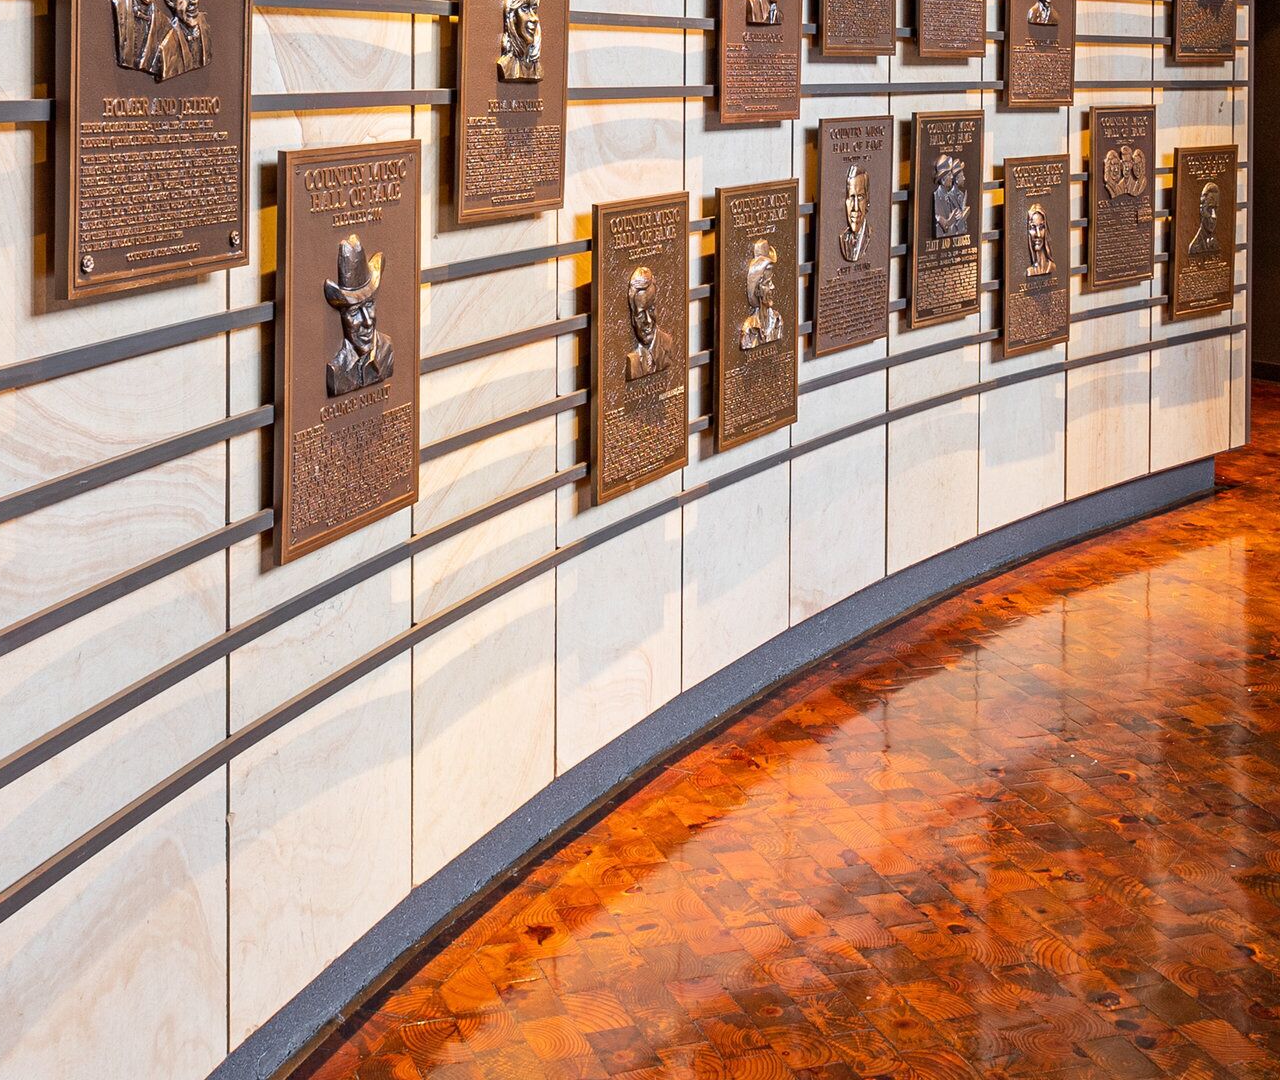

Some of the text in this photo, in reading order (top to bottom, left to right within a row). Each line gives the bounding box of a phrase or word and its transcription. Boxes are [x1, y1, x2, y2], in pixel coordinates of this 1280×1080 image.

[304, 158, 407, 192] COUNTRY MUSIC
[310, 181, 403, 214] HALL OF FAME
